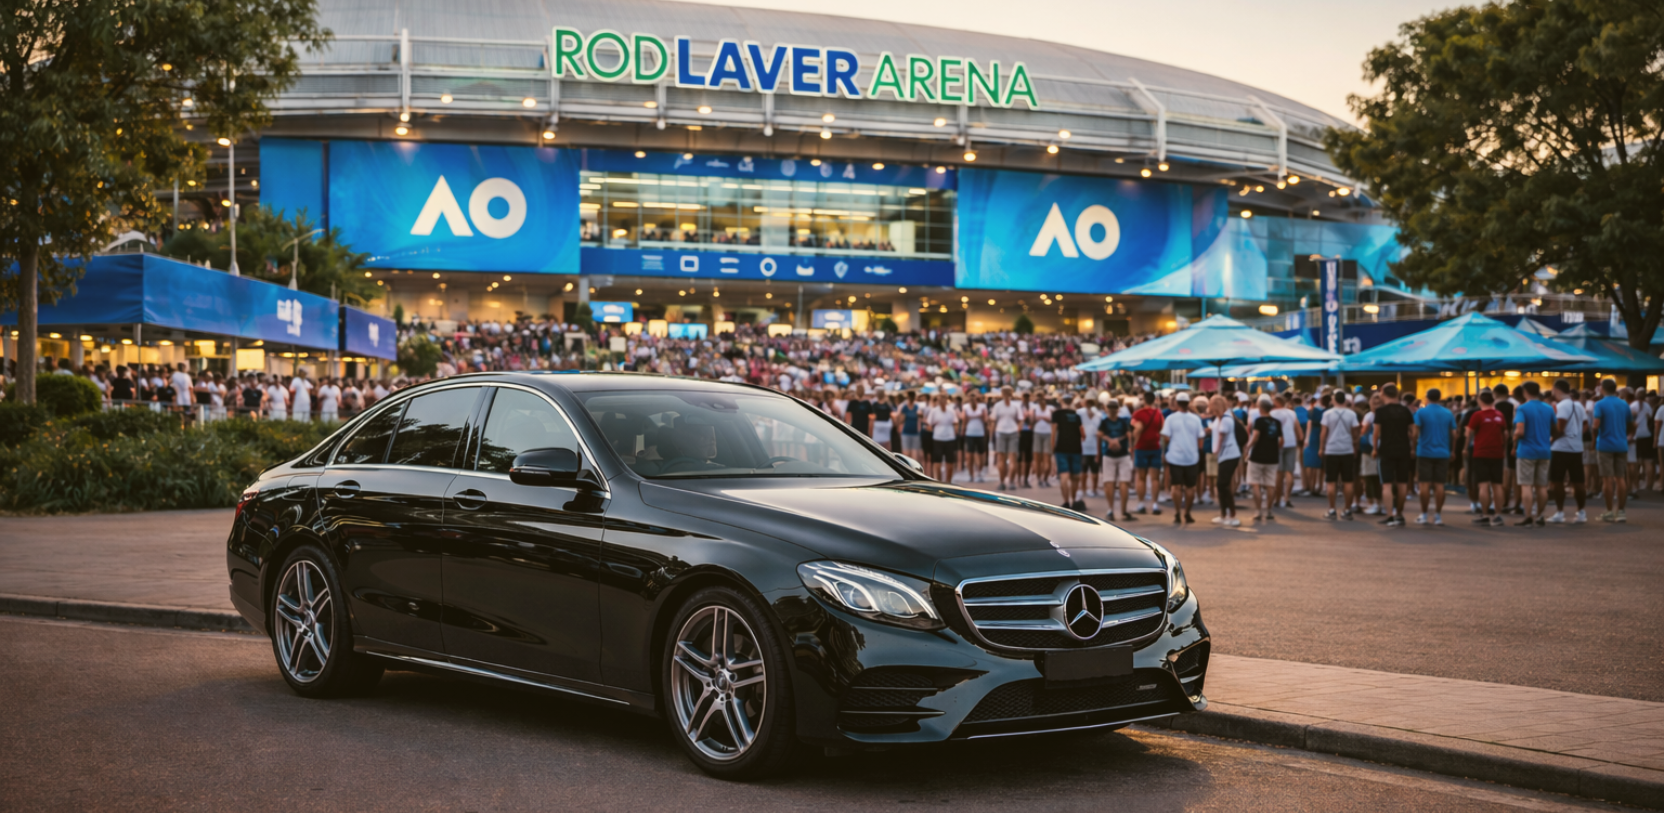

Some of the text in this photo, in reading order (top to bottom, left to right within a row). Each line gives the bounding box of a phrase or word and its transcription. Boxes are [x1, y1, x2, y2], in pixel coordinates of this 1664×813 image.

[554, 28, 1039, 109] ROD LAVER ARENA
[410, 174, 527, 239] AO
[1029, 202, 1120, 261] AO
